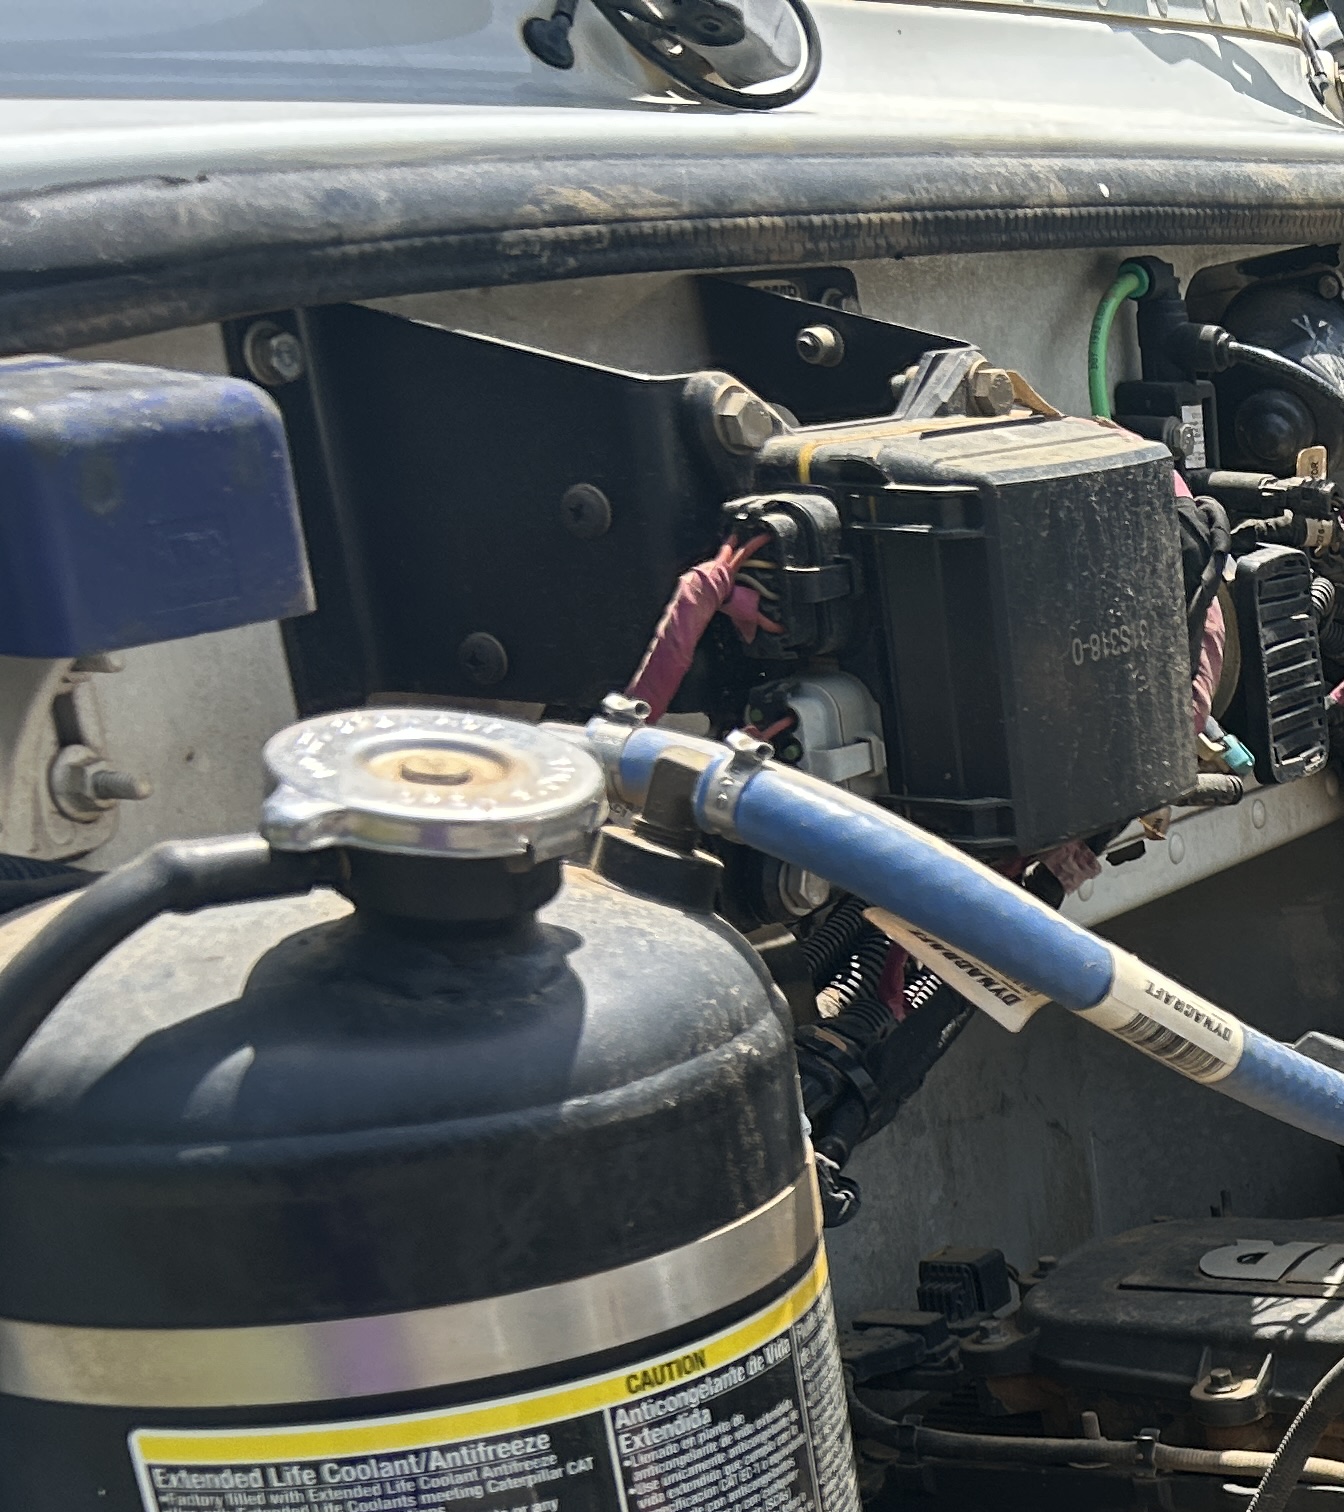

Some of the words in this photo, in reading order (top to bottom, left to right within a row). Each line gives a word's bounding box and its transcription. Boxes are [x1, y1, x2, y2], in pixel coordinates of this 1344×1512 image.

[1145, 980, 1234, 1042] DYNACRAFT
[615, 1365, 746, 1430] Anticongelante
[745, 1353, 765, 1375] de
[625, 1350, 706, 1394] CAUTION
[618, 1408, 713, 1454] Extendida
[153, 1467, 264, 1489] Extended
[266, 1465, 317, 1487] Life
[320, 1433, 551, 1483] Coolant/Antifreeze
[270, 1491, 304, 1504] with
[308, 1484, 382, 1501] Extended
[384, 1480, 416, 1495] Life
[418, 1473, 478, 1490] Coolant
[481, 1453, 557, 1480] Antifreeze
[347, 1493, 417, 1512] Coolants
[420, 1484, 483, 1502] meeting
[486, 1466, 564, 1492] Caterpillar
[565, 1456, 594, 1476] CAT
